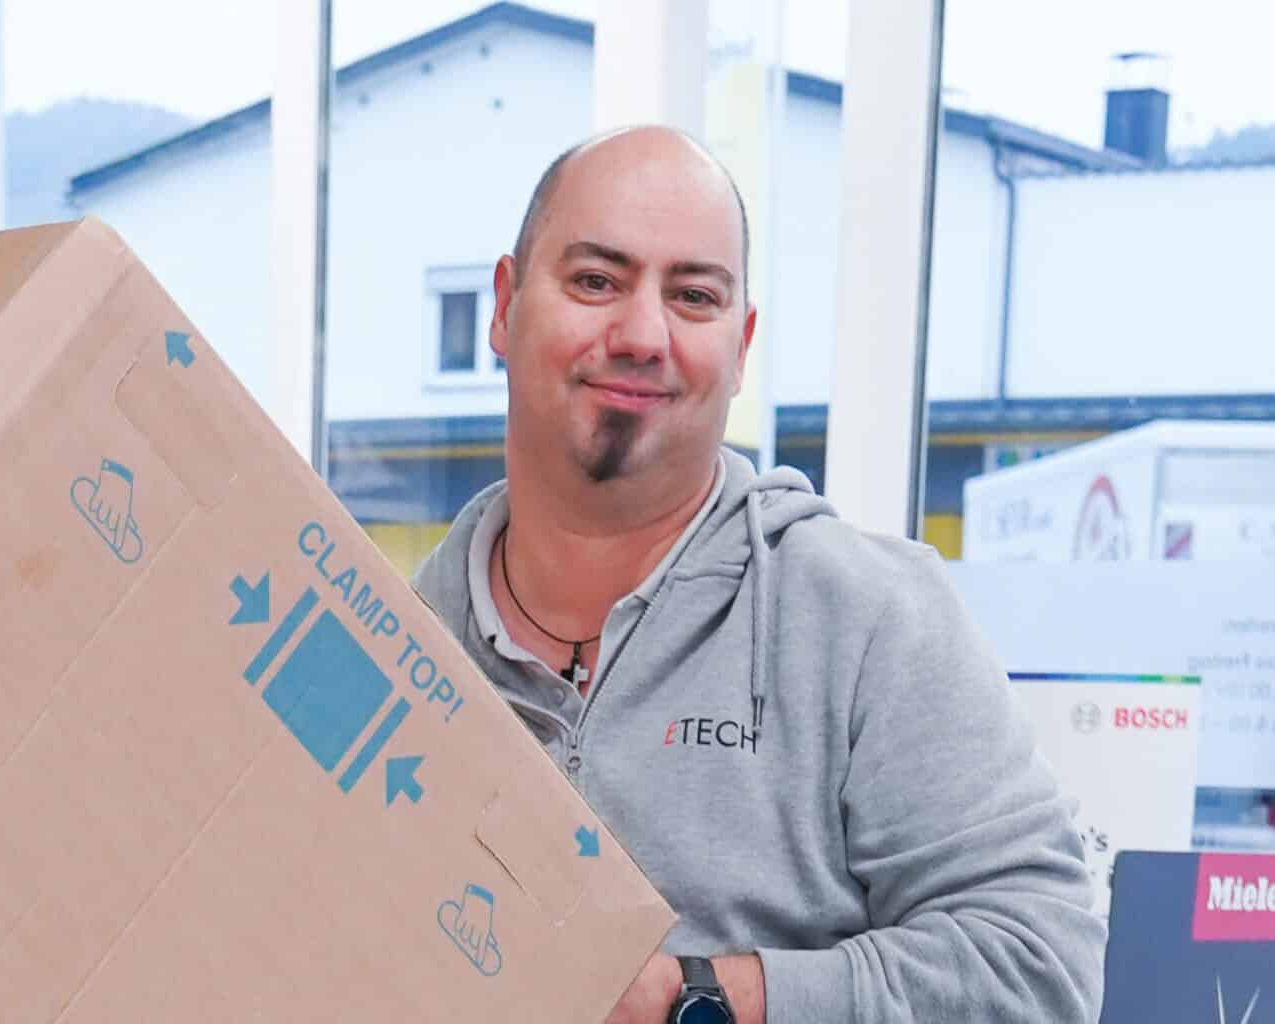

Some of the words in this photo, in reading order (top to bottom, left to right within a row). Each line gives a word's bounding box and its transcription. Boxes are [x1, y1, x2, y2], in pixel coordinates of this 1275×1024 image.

[297, 520, 400, 644] CLAMP
[396, 633, 464, 723] TOP!
[1113, 706, 1188, 730] BOSCH
